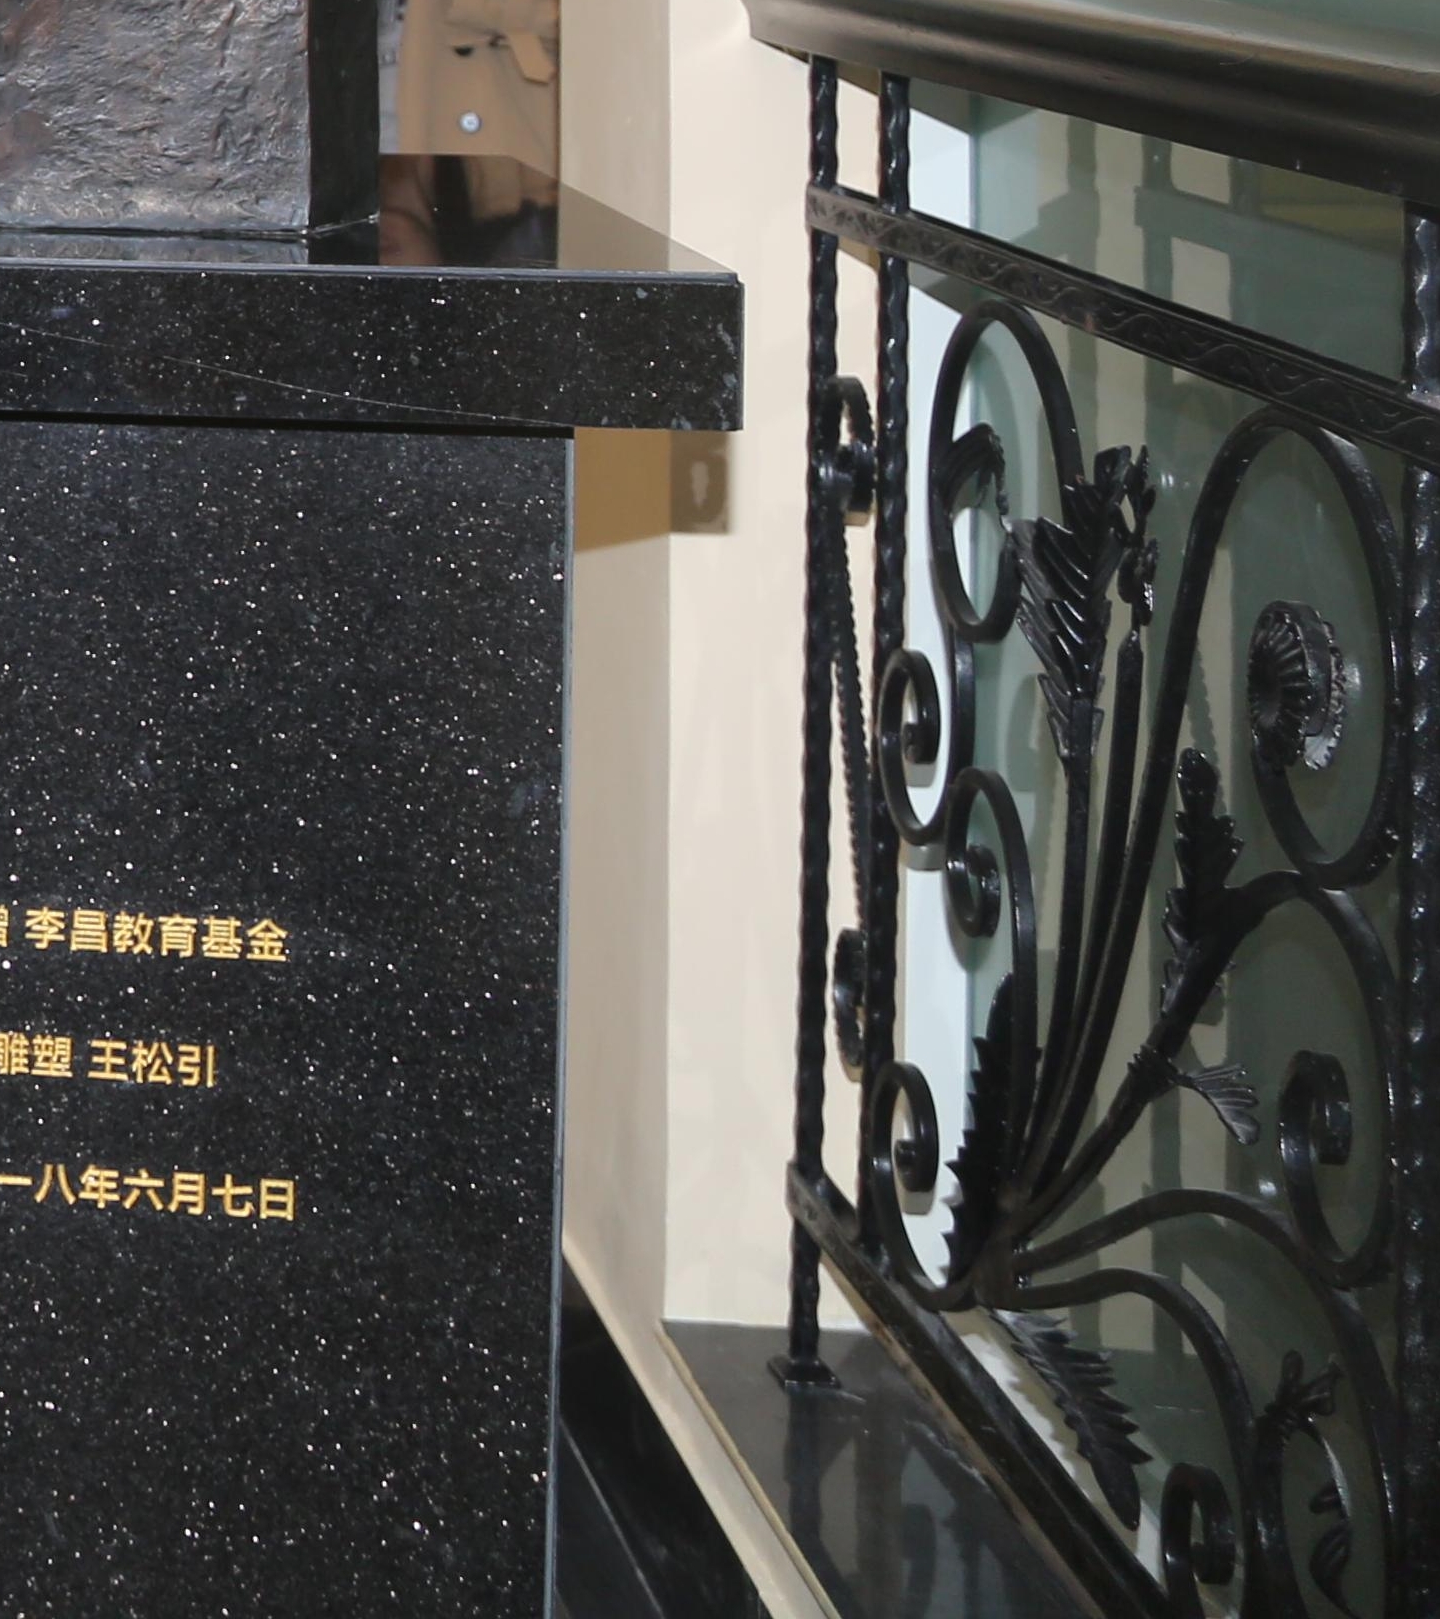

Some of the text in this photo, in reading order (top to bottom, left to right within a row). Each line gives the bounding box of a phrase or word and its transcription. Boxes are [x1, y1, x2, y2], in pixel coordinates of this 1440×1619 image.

[24, 905, 289, 963] 李昌教育基金
[87, 1038, 215, 1088] 王松引
